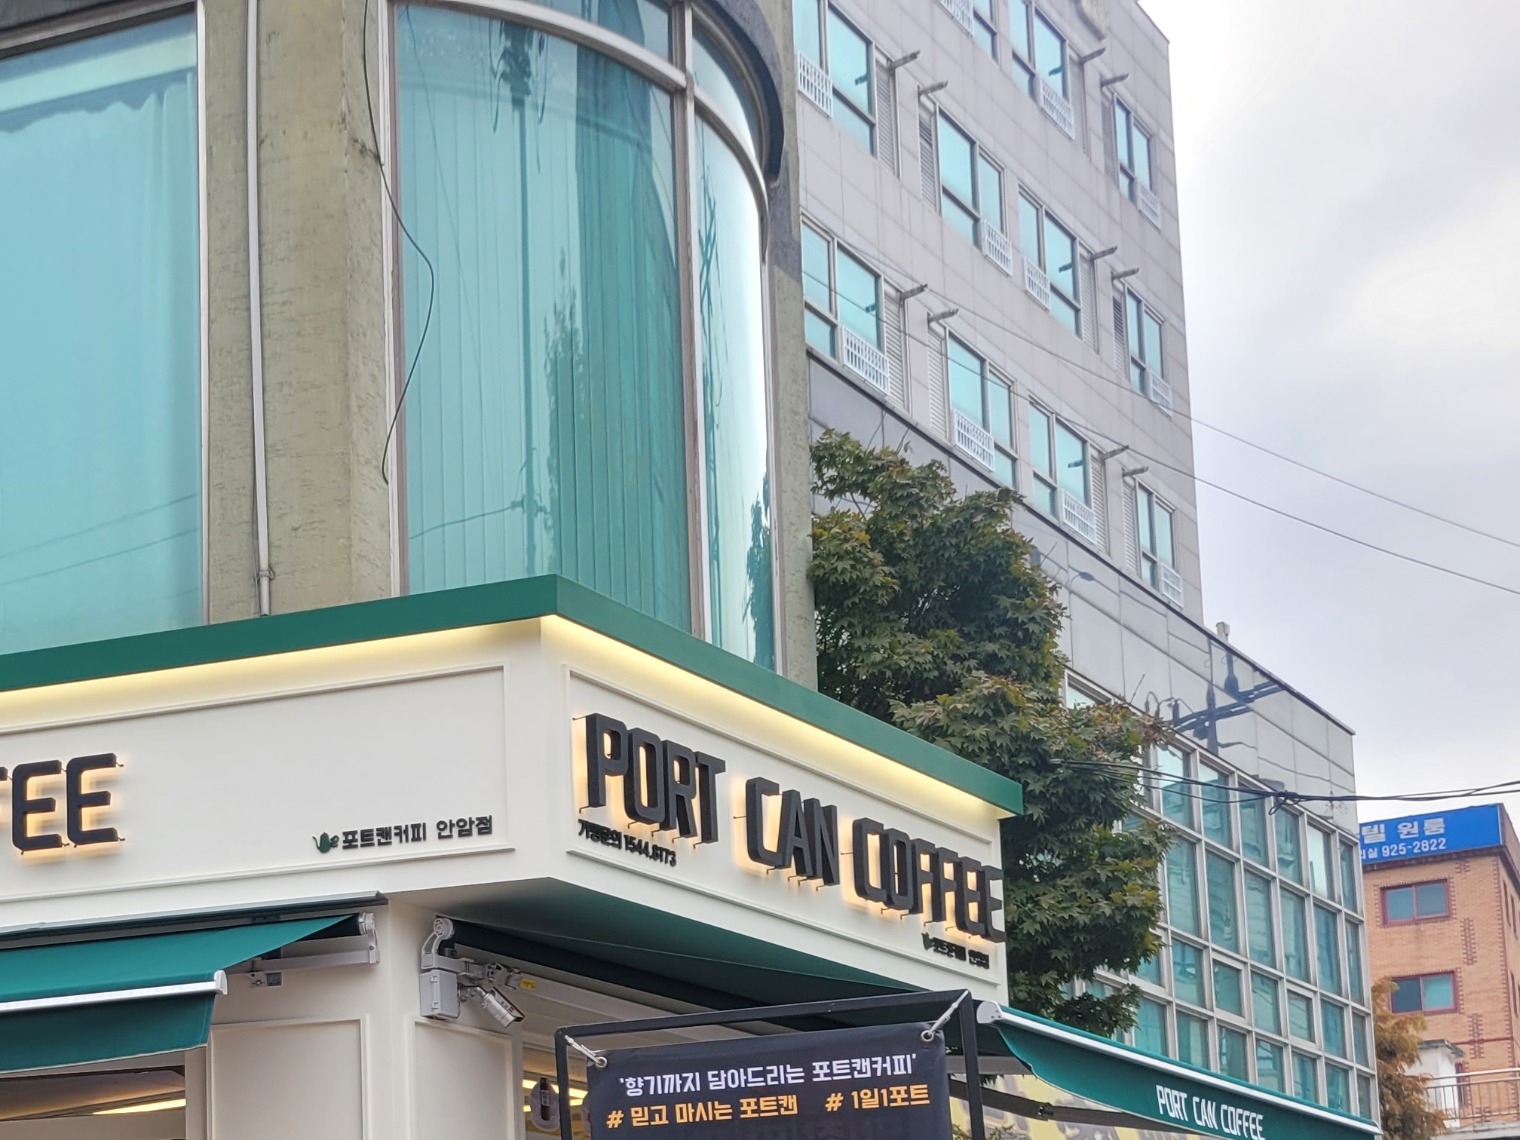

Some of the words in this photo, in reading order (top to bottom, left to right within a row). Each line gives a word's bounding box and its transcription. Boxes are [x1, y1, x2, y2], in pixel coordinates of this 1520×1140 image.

[341, 820, 428, 850] 포트캔커피
[435, 814, 494, 840] 안암점
[585, 713, 726, 843] PORT
[744, 777, 840, 886] CAN
[851, 817, 1006, 943] COFFEE
[1397, 817, 1445, 840] 원룸
[624, 834, 676, 867] 1544.8173
[1382, 838, 1446, 857] 925-2822
[707, 1063, 804, 1091] 담아드리는
[606, 1109, 623, 1129] #
[631, 1106, 669, 1126] 믿고
[675, 1100, 733, 1123] 마시는
[739, 1094, 798, 1118] 포트캔
[825, 1093, 843, 1112] #
[851, 1084, 930, 1110] 1일1포트
[1156, 1085, 1188, 1121] PORT
[1192, 1096, 1218, 1130] CAN
